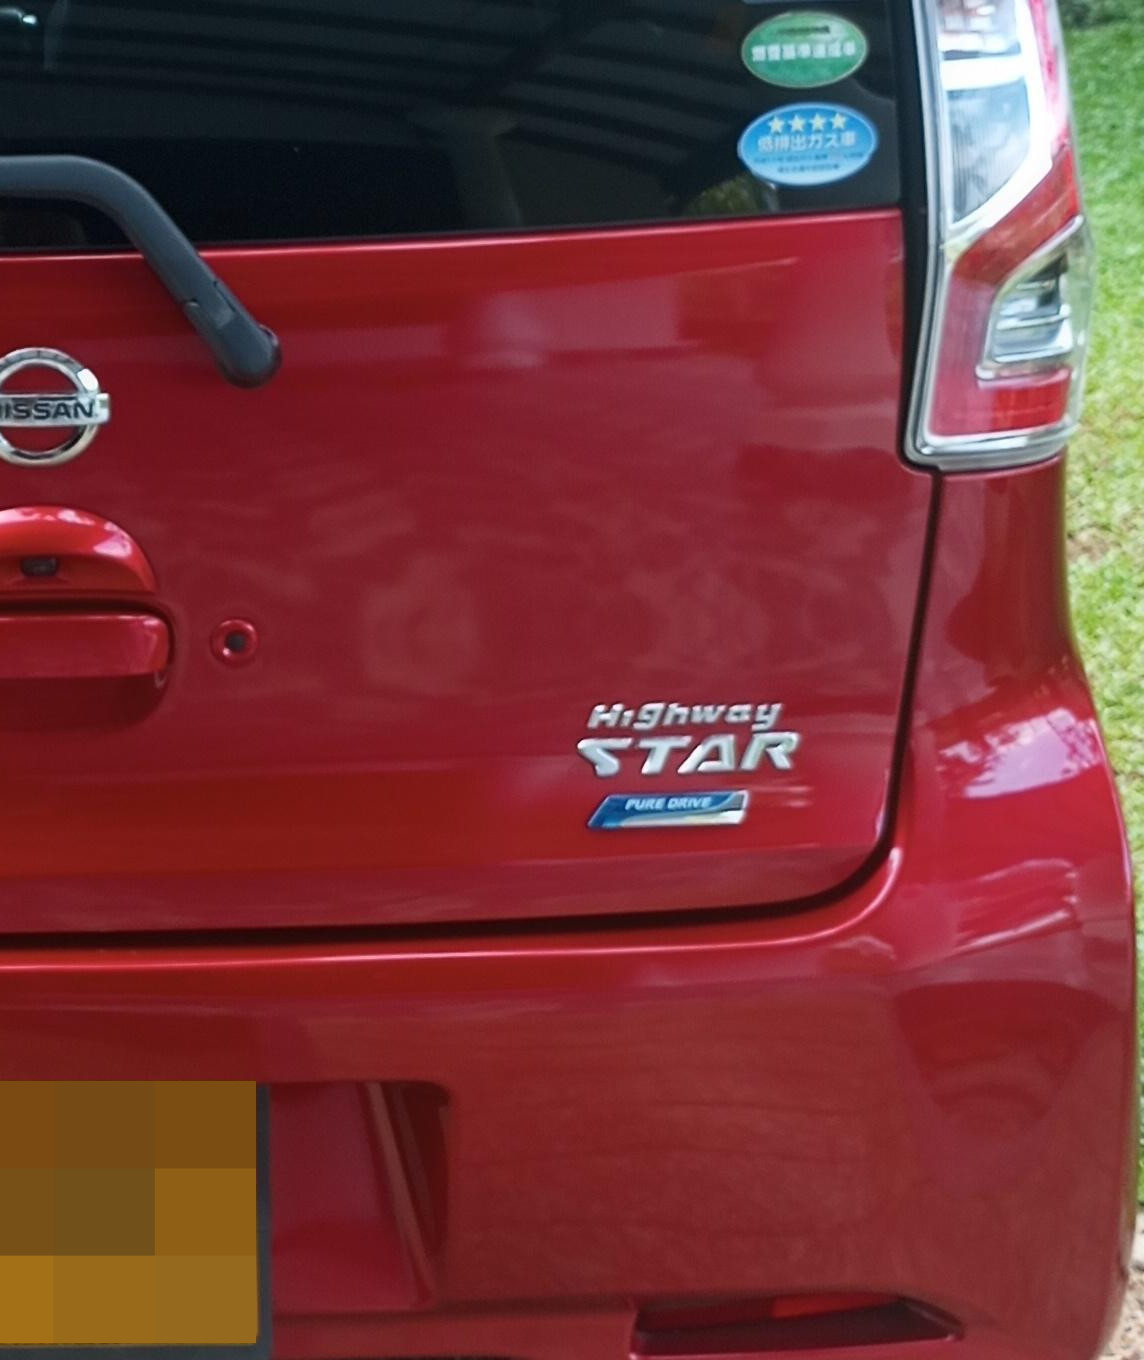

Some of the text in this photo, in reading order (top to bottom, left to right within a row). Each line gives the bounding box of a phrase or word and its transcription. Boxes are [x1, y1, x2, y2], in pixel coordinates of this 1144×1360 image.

[758, 130, 857, 153] 排出ガス
[587, 702, 785, 732] Highway
[577, 731, 801, 776] STAR
[625, 796, 713, 811] PURE DRIVE
